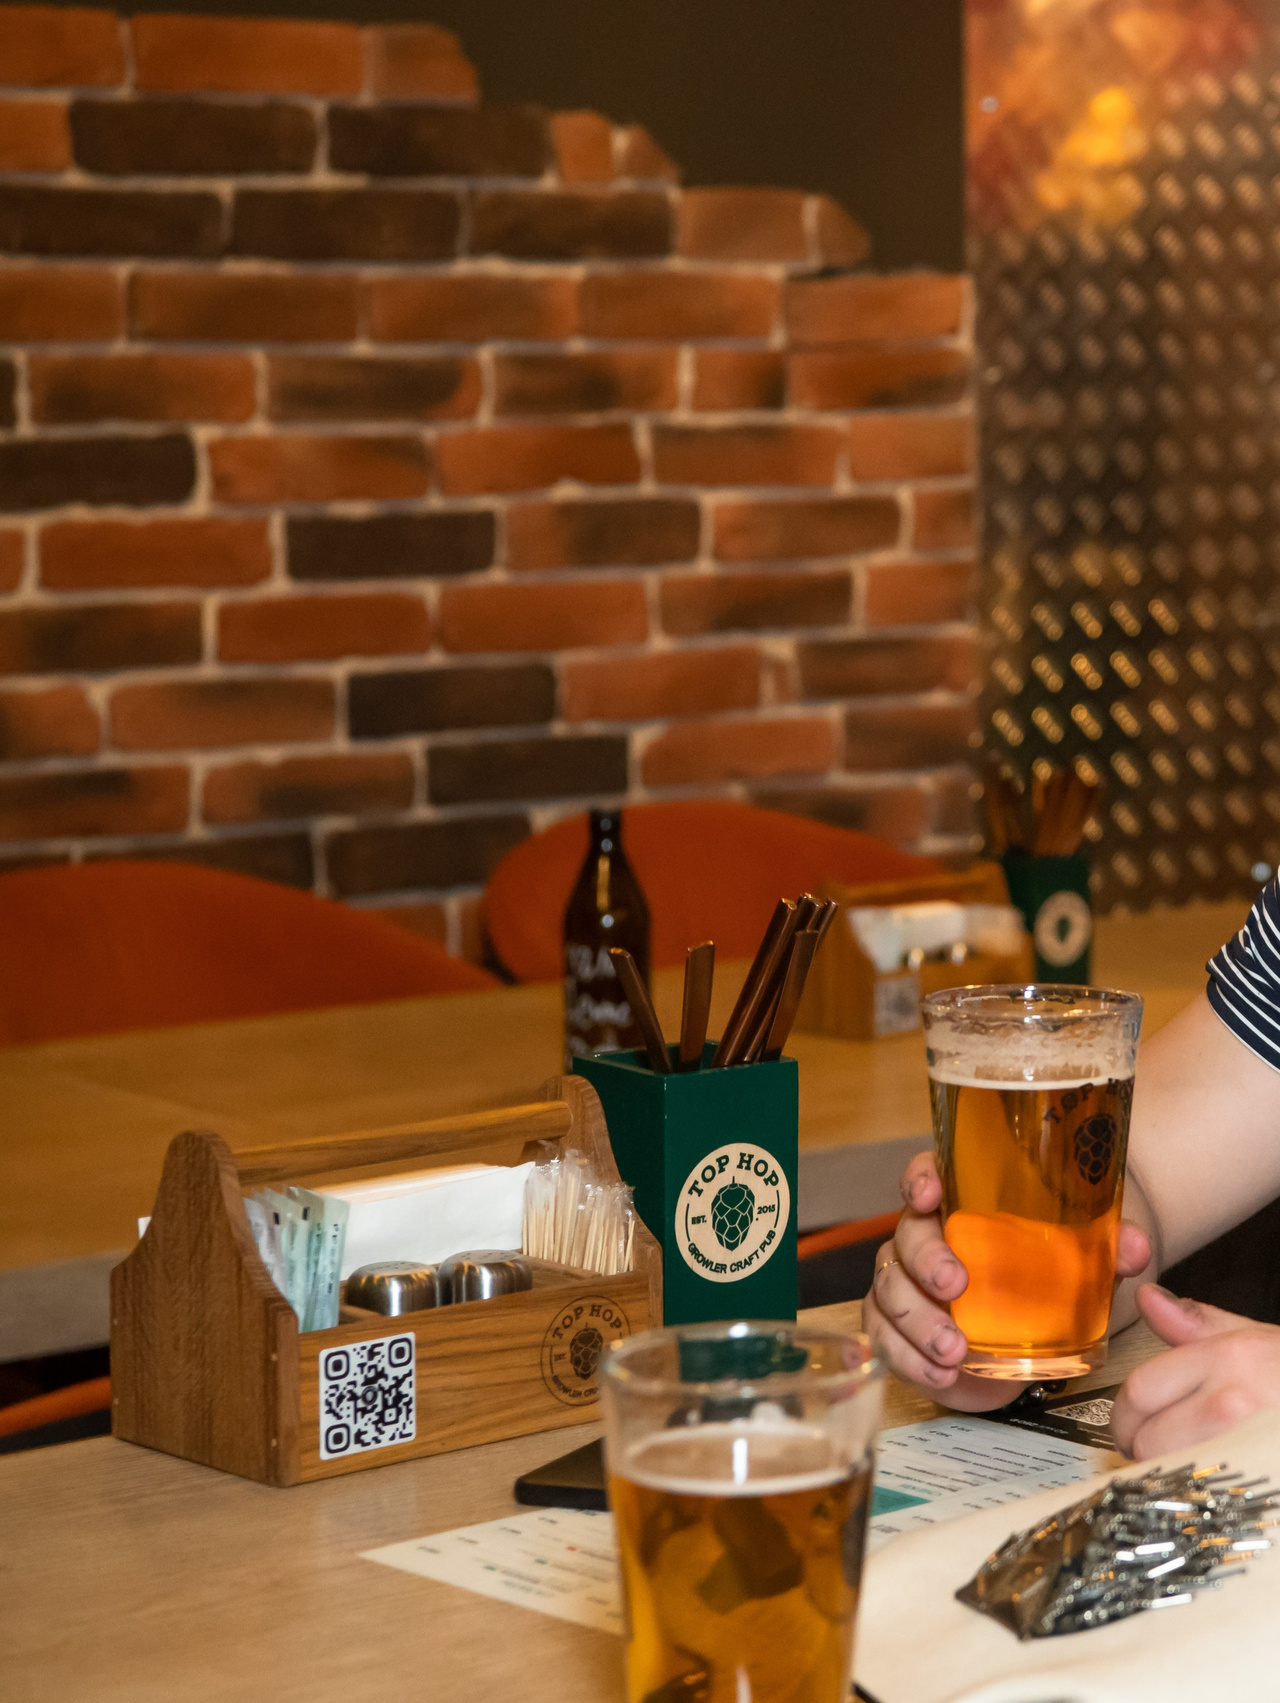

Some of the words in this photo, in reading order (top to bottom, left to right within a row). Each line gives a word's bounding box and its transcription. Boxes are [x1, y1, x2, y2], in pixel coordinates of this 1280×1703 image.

[687, 1154, 730, 1198] TOP
[736, 1151, 780, 1187] HOP
[687, 1242, 727, 1274] GROWLER
[729, 1249, 760, 1274] CRAFT
[760, 1229, 777, 1253] PUB
[552, 1306, 584, 1339] TOP
[589, 1304, 622, 1329] HOP
